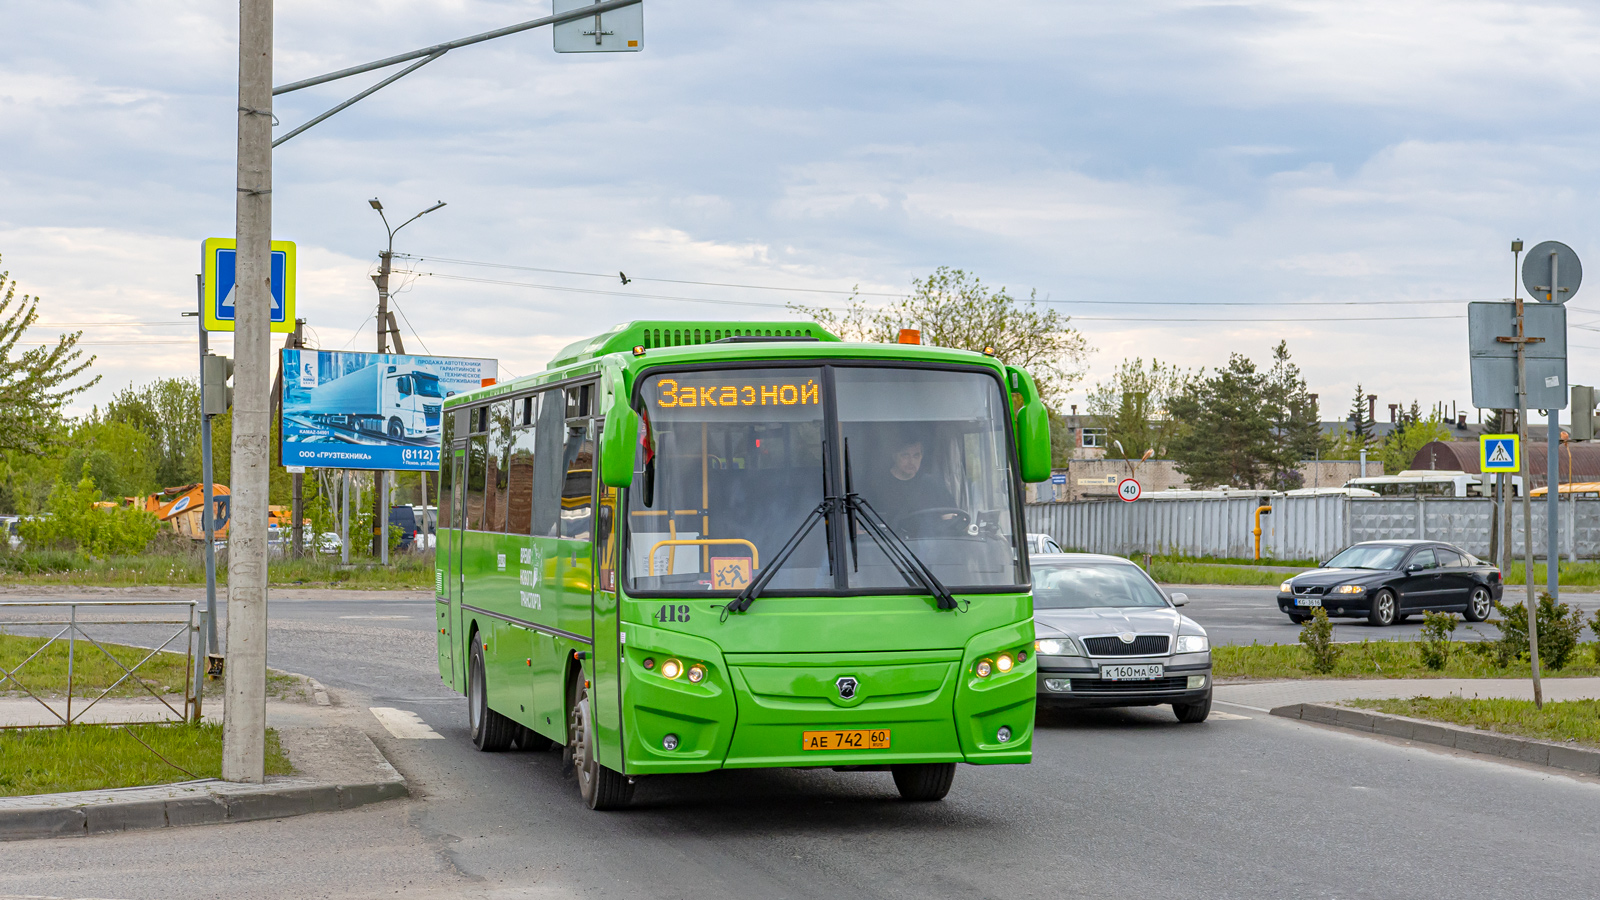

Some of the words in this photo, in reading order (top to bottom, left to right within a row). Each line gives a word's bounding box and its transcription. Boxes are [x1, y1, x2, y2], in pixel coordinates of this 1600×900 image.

[657, 379, 819, 407] Заказной
[317, 451, 372, 460] «ГРУЗТЕХНИКА»
[402, 448, 433, 462] (8112)
[1124, 486, 1136, 495] 40
[654, 604, 691, 623] 418
[835, 732, 862, 747] 742
[871, 731, 885, 742] 60
